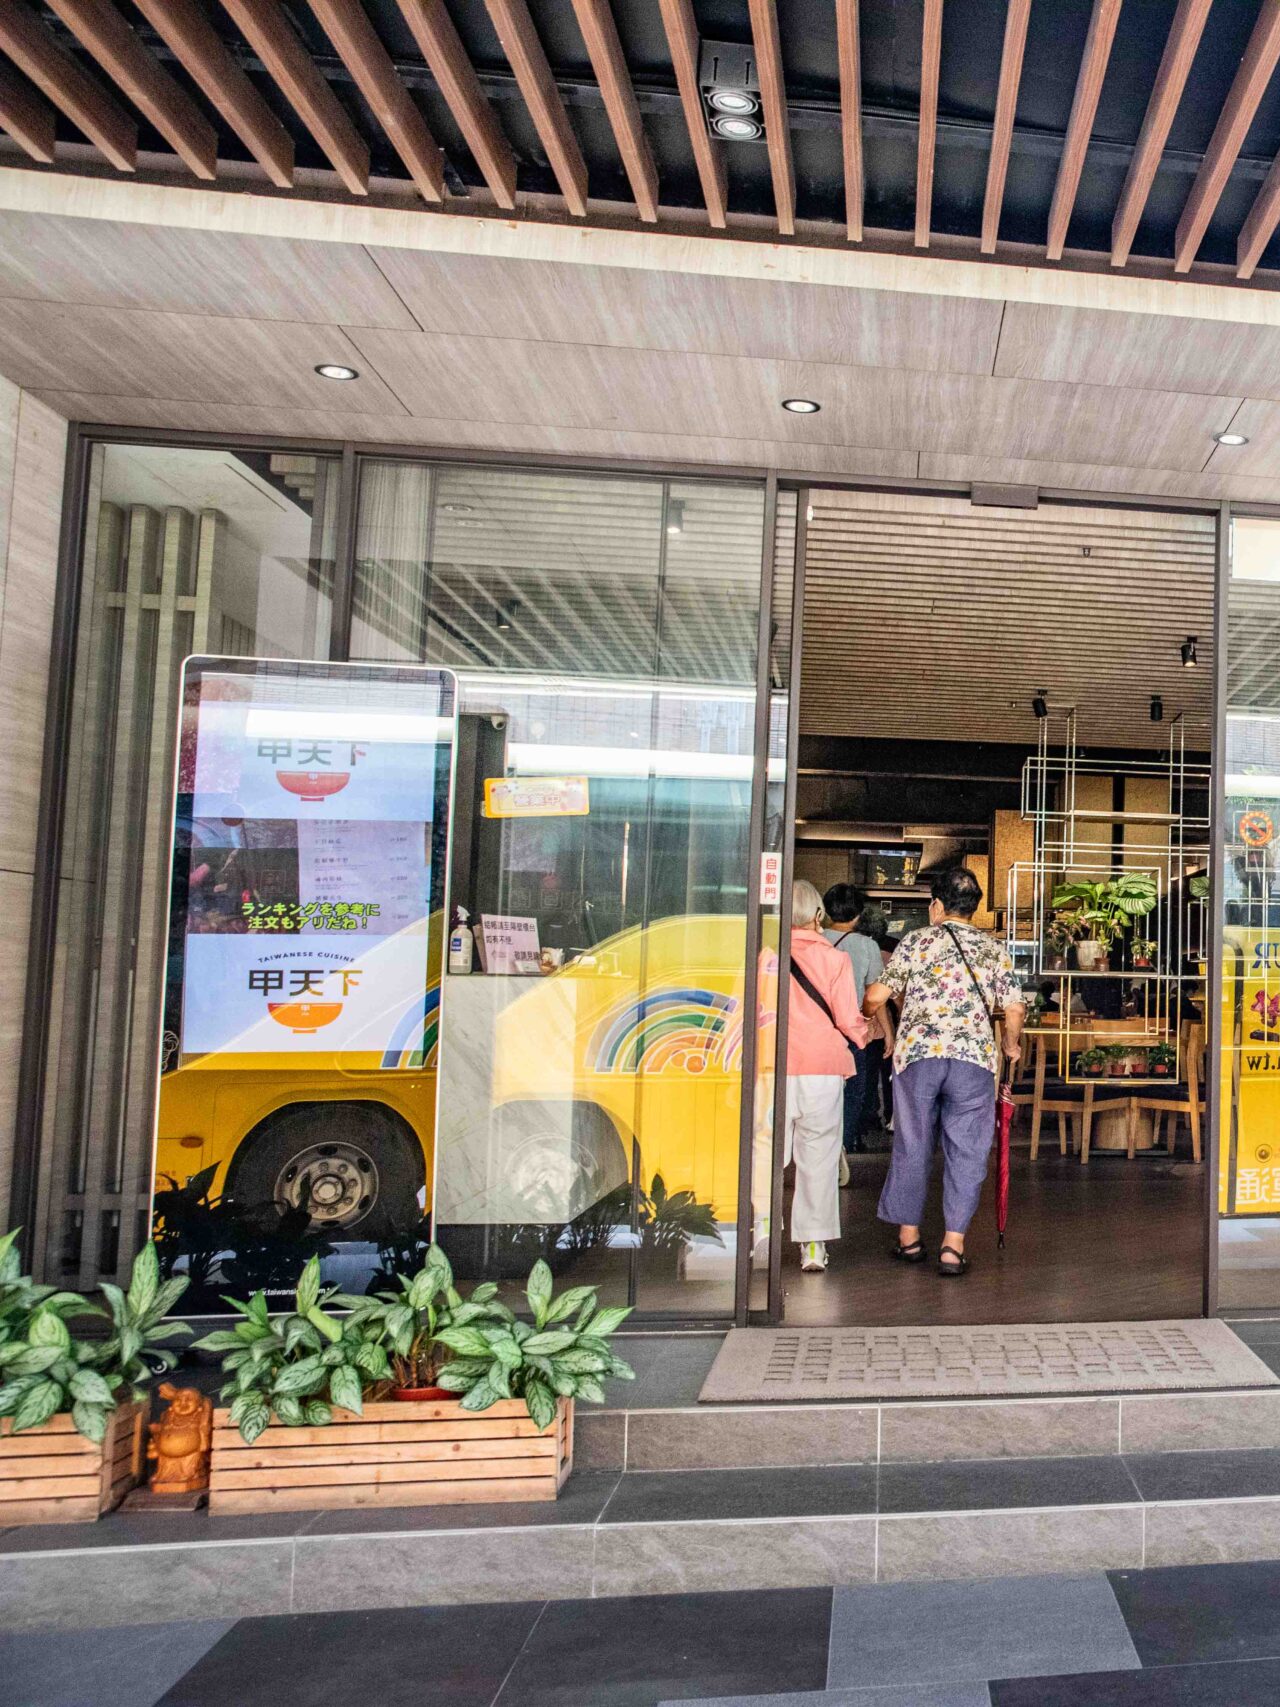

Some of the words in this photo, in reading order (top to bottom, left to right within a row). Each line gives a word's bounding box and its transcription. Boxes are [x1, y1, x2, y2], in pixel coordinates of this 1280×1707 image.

[765, 858, 777, 899] 自動門
[241, 902, 381, 918] ランキングを参考に
[258, 951, 313, 964] TAIWANESE
[317, 951, 356, 963] CUISINE
[248, 969, 363, 997] 甲天下
